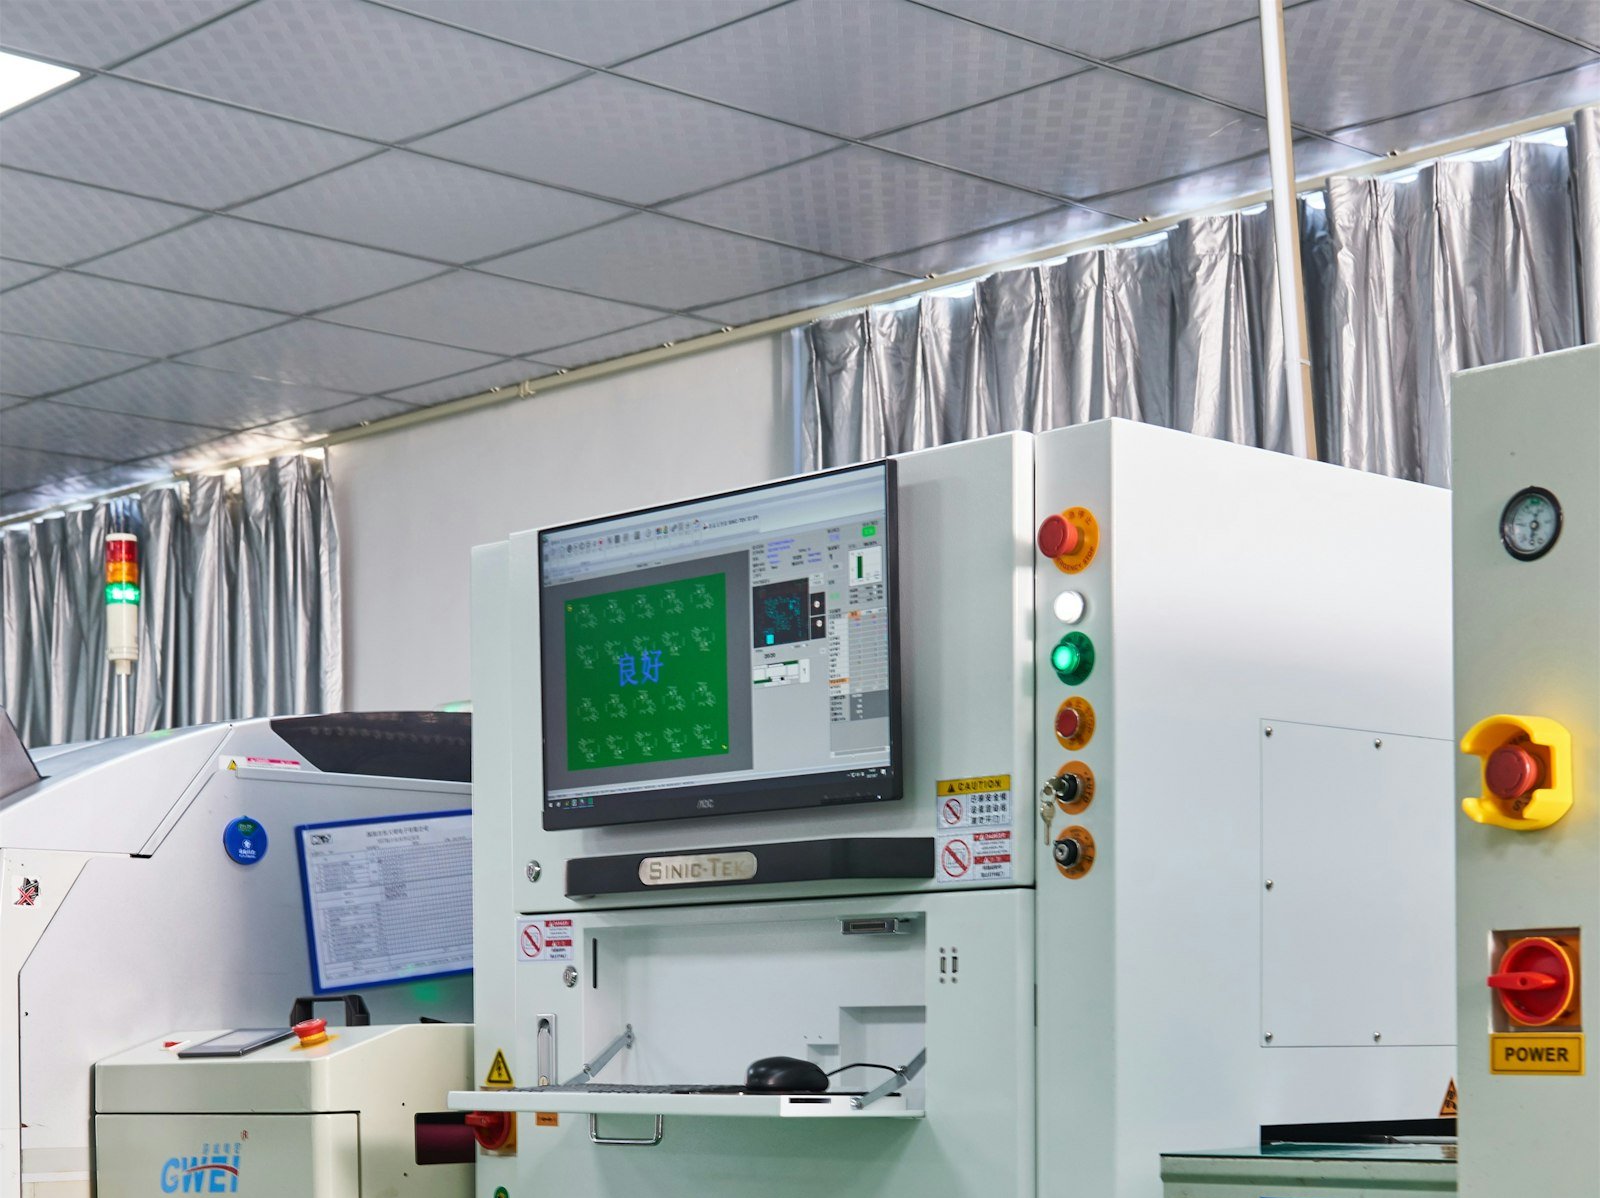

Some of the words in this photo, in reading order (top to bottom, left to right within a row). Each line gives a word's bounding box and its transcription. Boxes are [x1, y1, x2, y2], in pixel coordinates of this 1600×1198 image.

[618, 650, 664, 688] 良好
[957, 779, 1002, 791] CAUTION
[1504, 1046, 1569, 1063] POWER
[160, 1155, 240, 1194] GWEI
